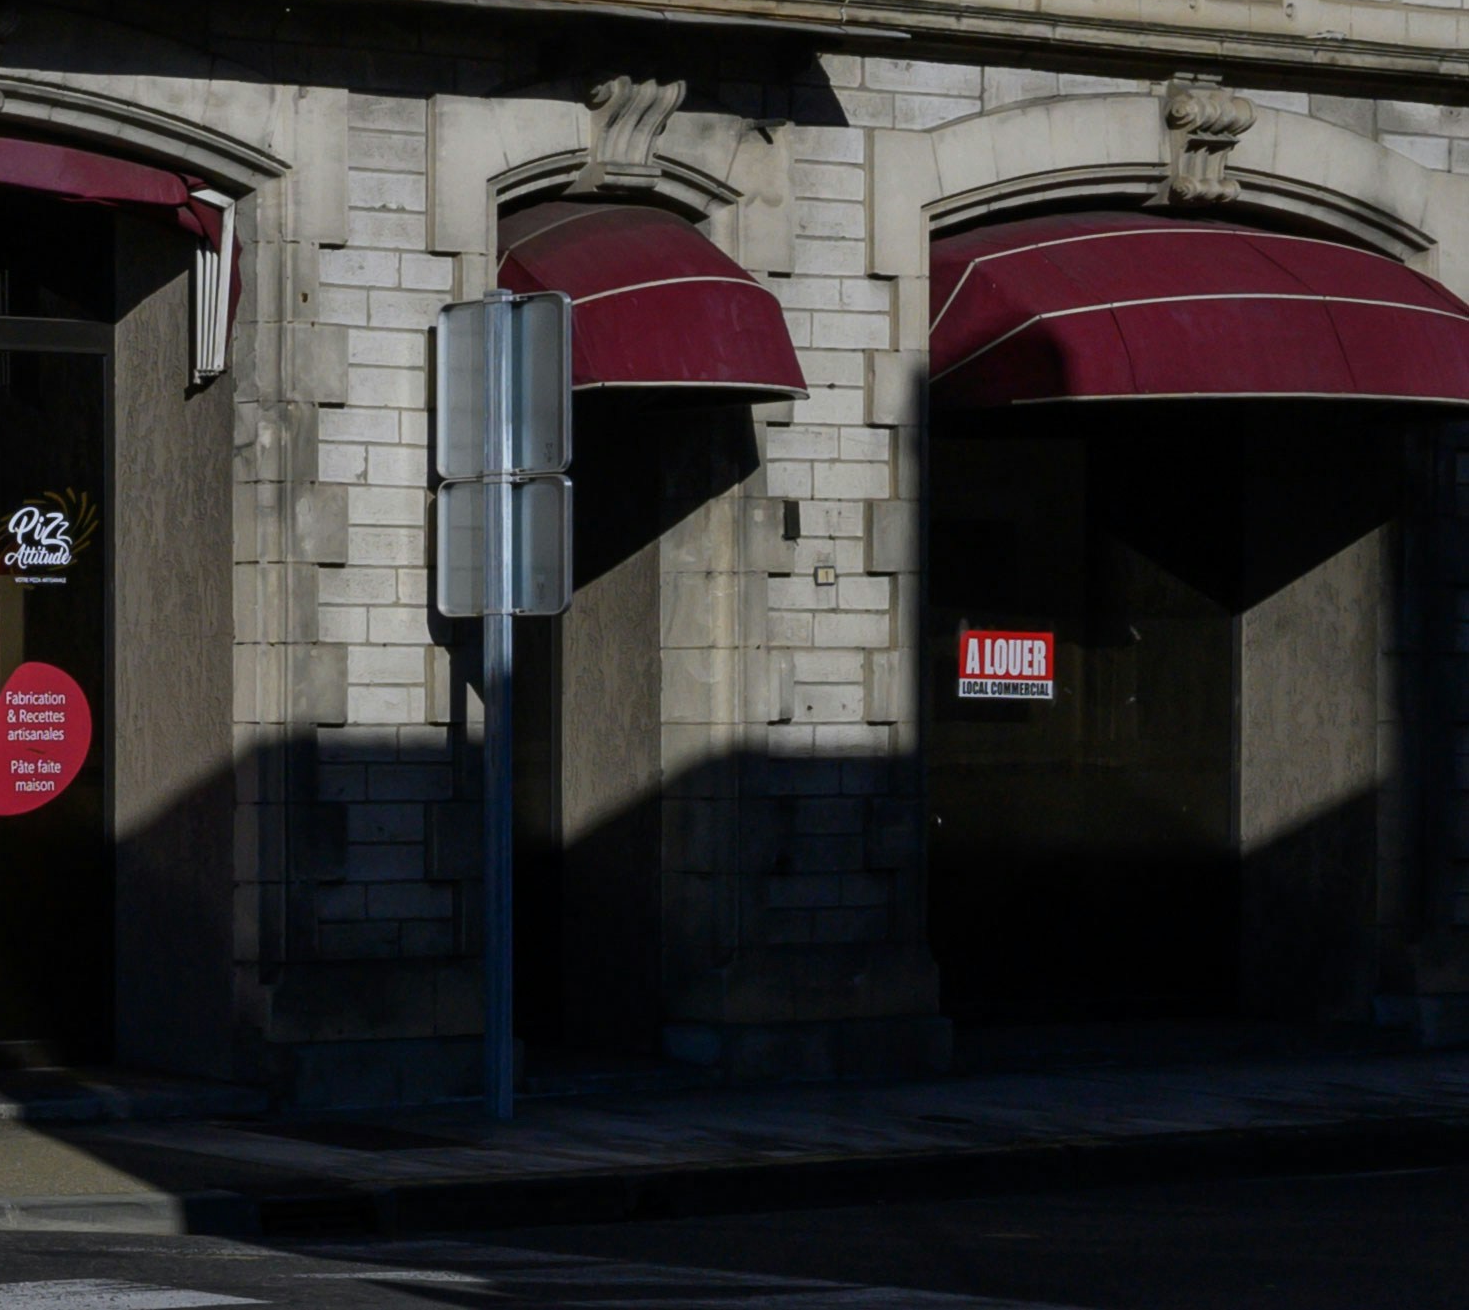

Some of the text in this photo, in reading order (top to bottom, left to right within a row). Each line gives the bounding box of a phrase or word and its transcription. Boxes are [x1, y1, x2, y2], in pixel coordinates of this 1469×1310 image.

[4, 543, 72, 569] Attitude
[966, 638, 1046, 677] A LOUER
[962, 680, 1050, 697] LOCAL COMMERCIAL
[6, 691, 66, 706] Fabrication
[7, 709, 66, 723] & Recettes
[7, 727, 65, 741] artisanales
[10, 759, 62, 774] Pâte faite
[15, 777, 55, 792] maison
